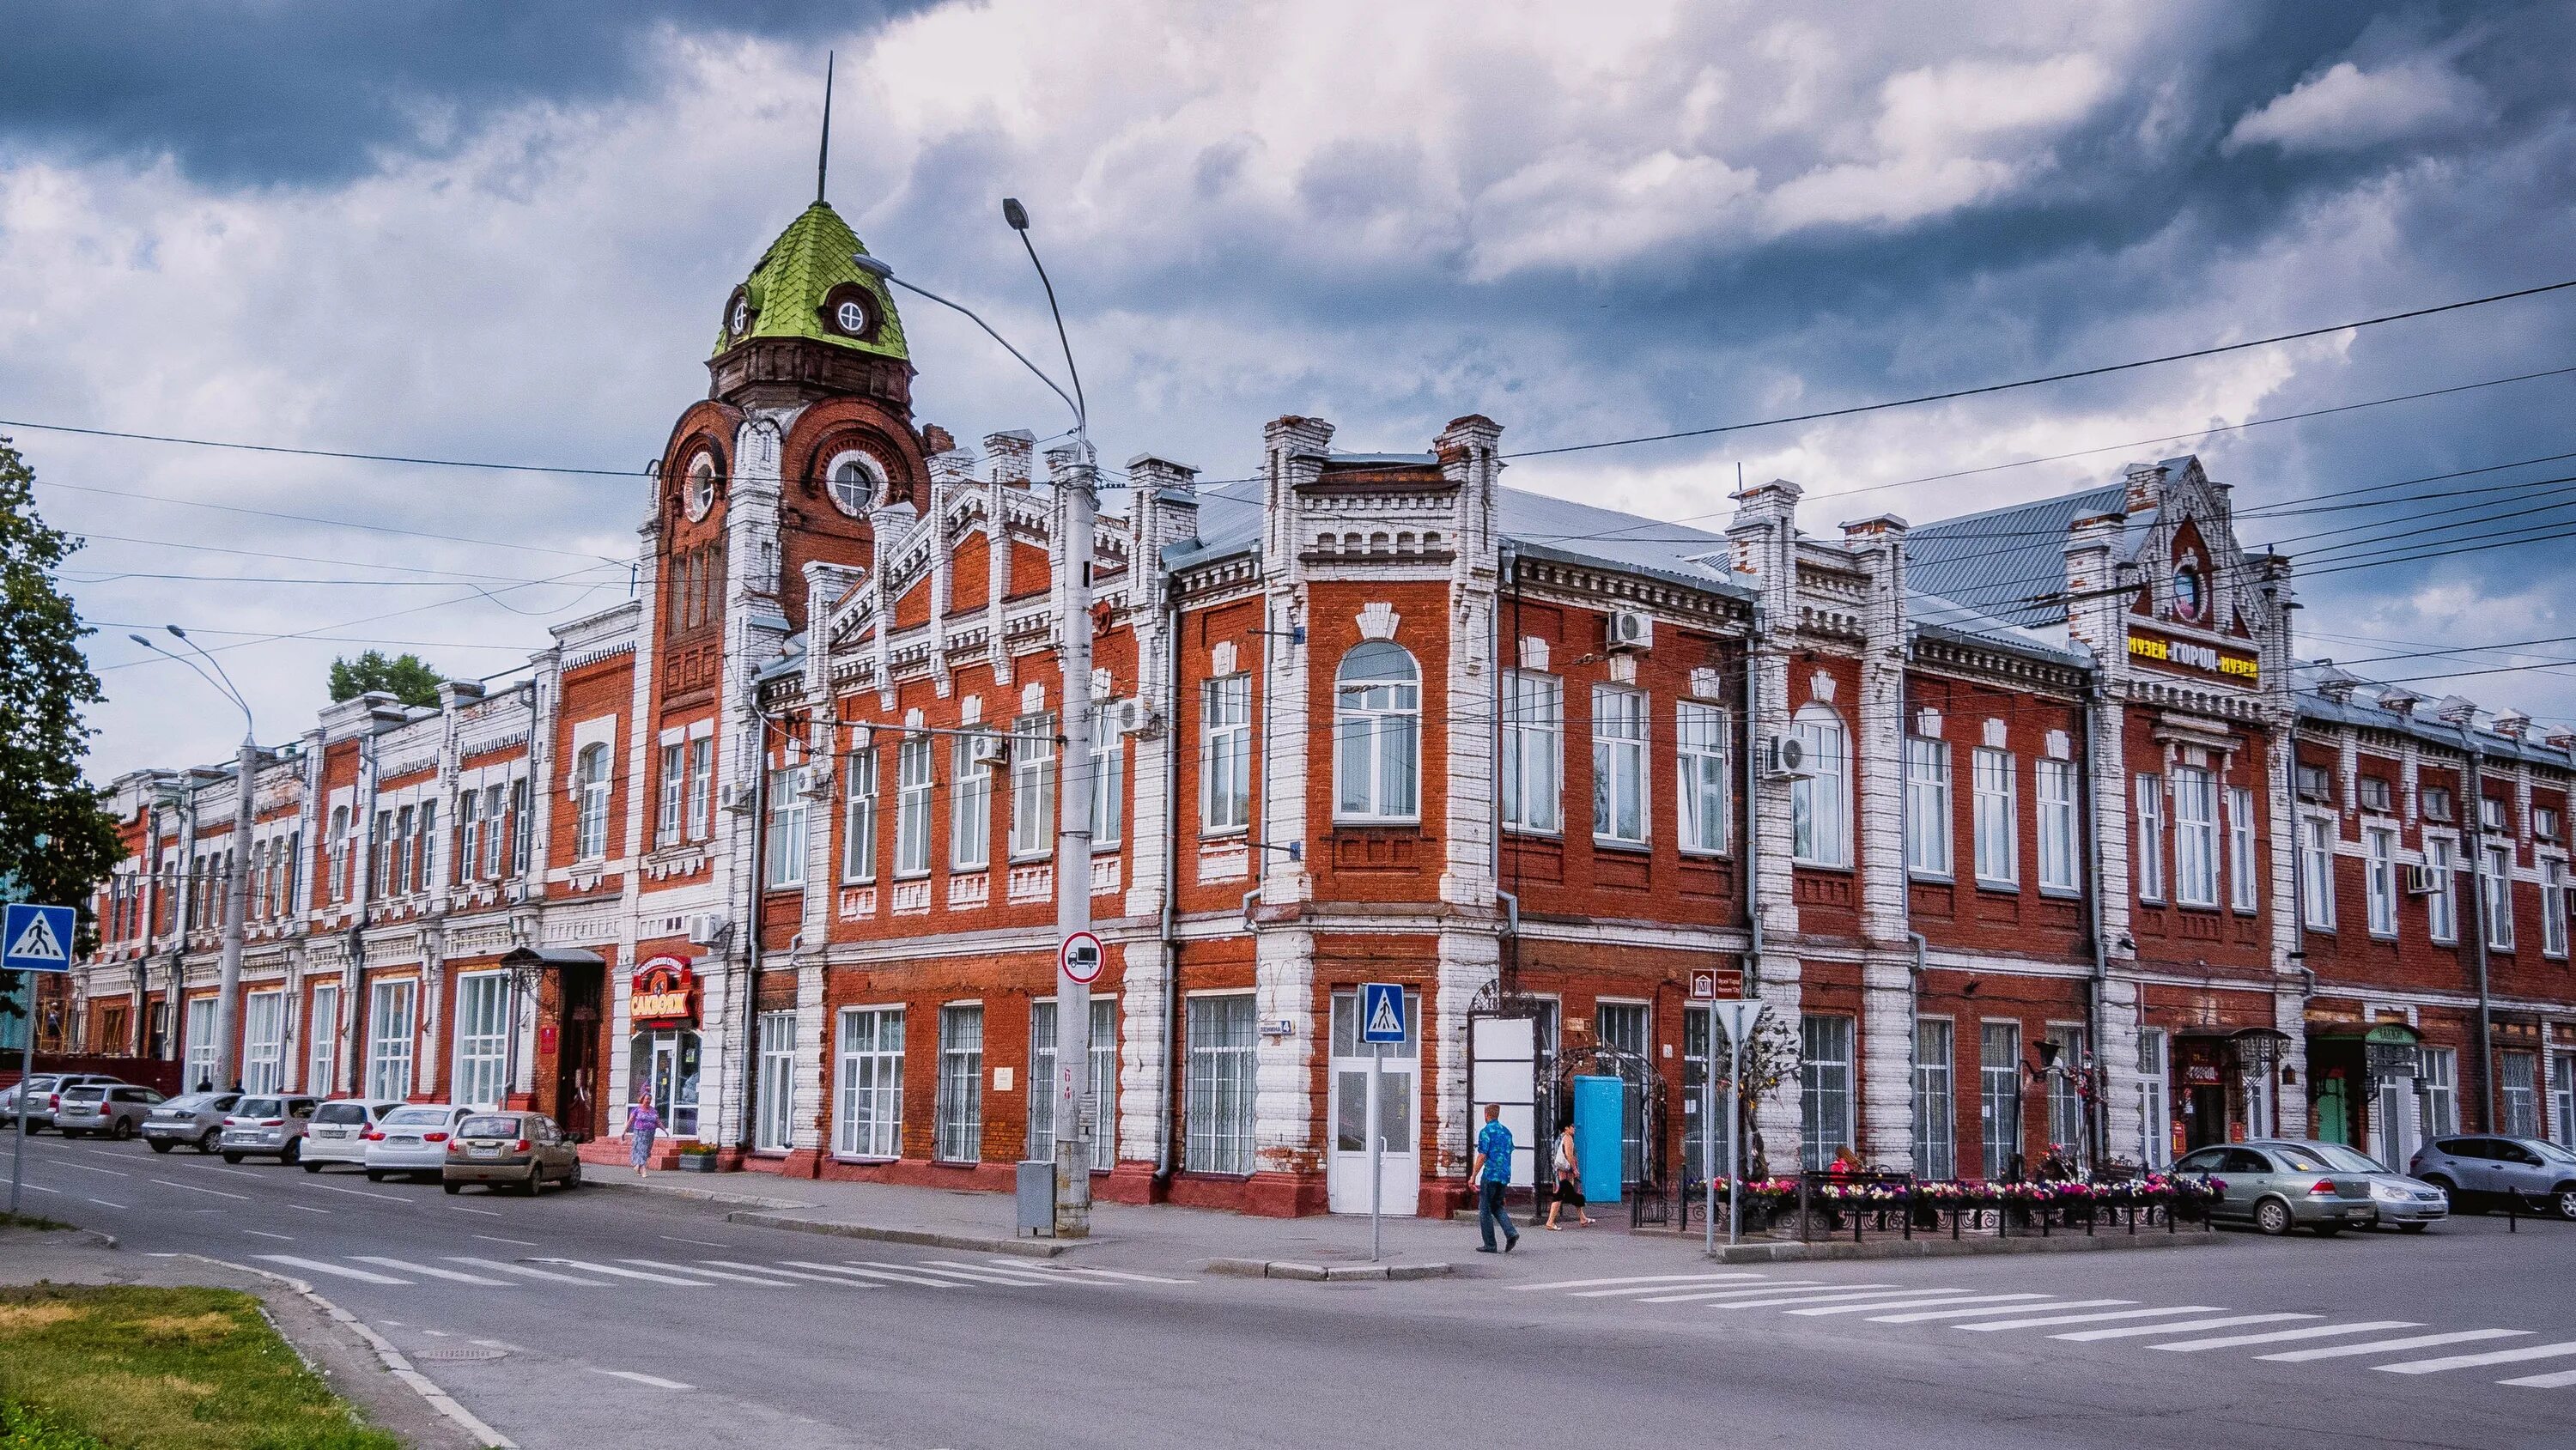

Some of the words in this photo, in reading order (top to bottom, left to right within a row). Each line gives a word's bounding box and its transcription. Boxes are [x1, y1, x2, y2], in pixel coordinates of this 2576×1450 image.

[2128, 636, 2167, 660] МУЗЕЙ
[2220, 656, 2258, 678] МУЗЕЙ
[631, 993, 686, 1016] САКВОЯЖ
[1283, 1022, 1290, 1032] 4
